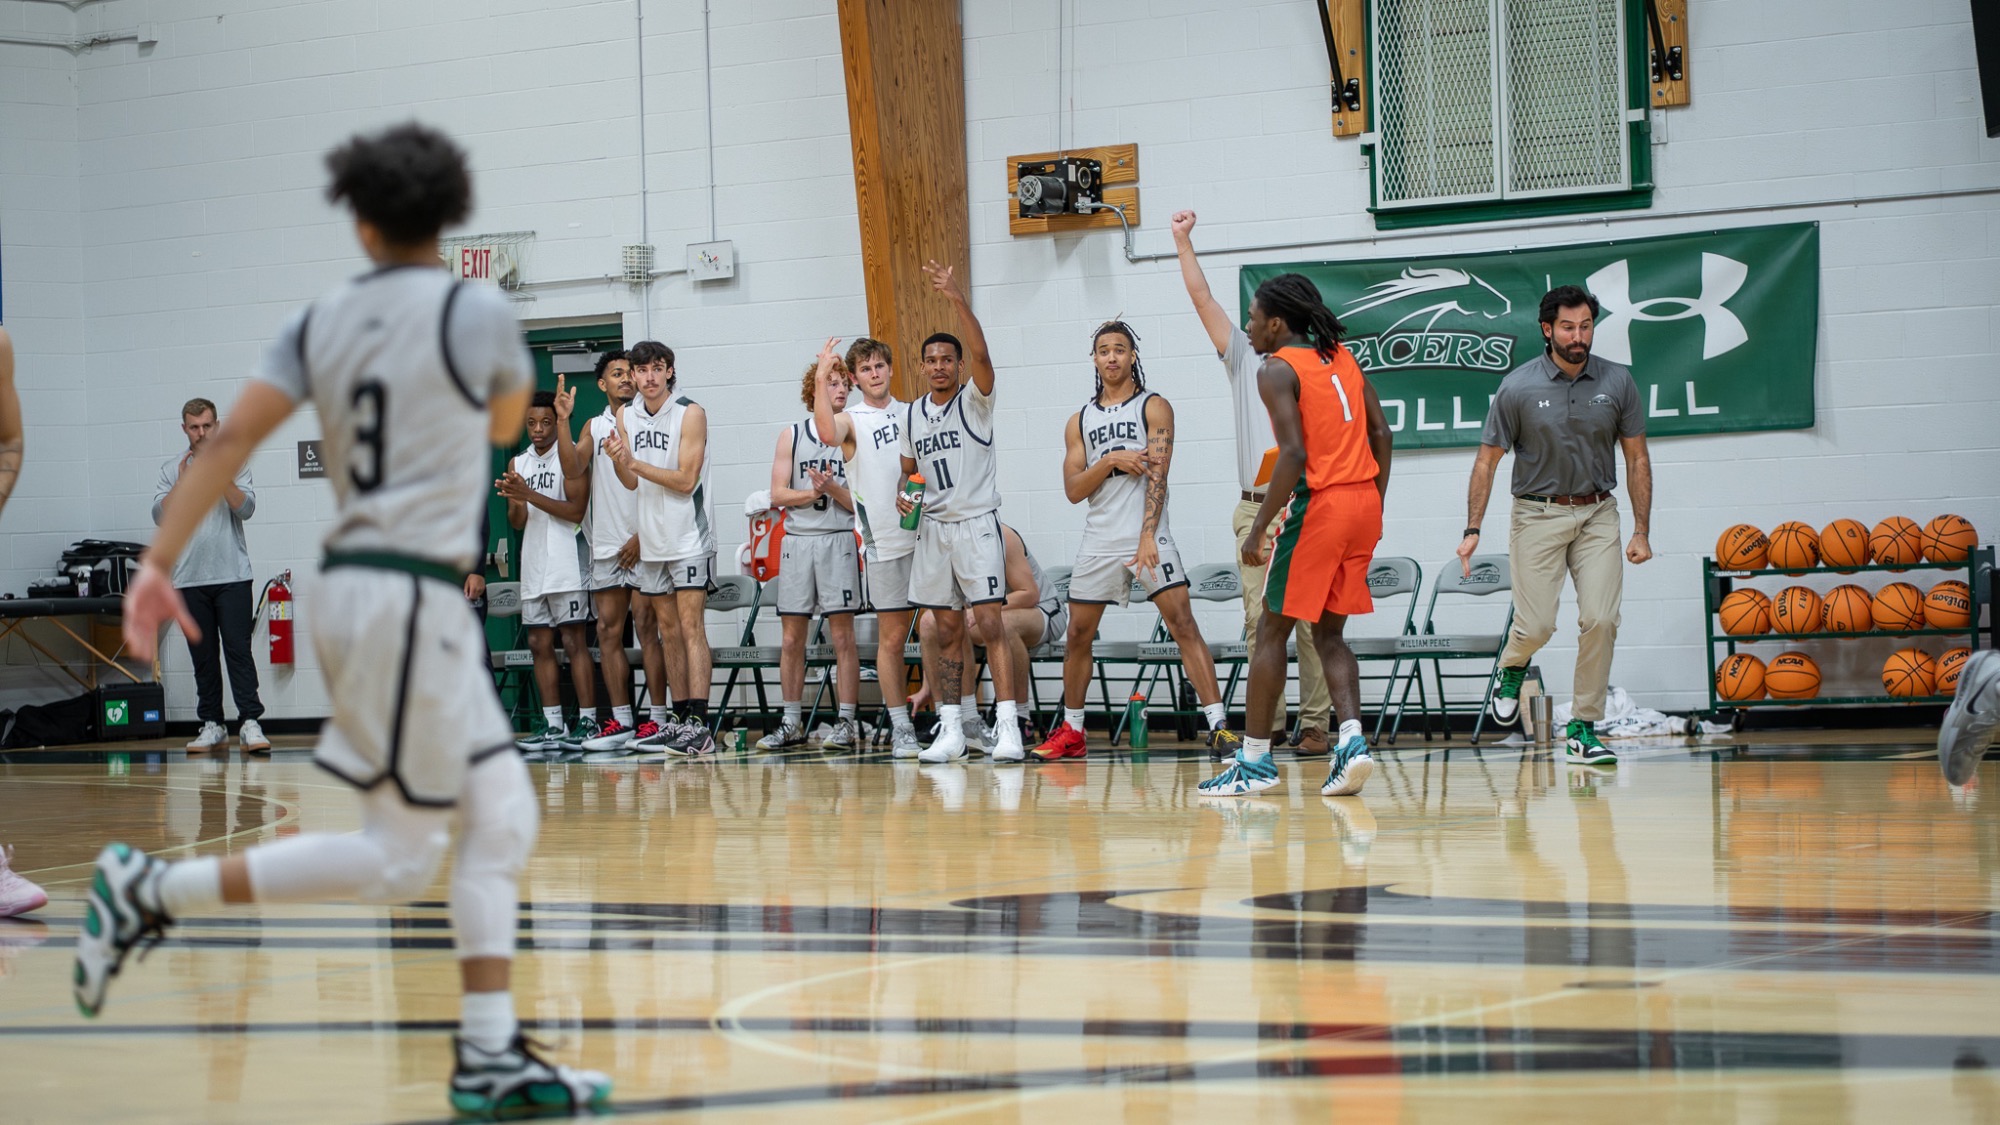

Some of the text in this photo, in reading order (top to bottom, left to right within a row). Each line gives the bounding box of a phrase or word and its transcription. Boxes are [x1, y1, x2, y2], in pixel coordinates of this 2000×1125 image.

[462, 249, 491, 279] EXIT
[1331, 373, 1354, 422] 1
[350, 379, 387, 494] 3
[634, 430, 670, 452] PEACE
[873, 423, 900, 450] PEA
[915, 430, 961, 460] PEACE
[1089, 421, 1137, 450] PEACE
[932, 457, 954, 491] 11
[752, 513, 767, 537] G
[687, 565, 697, 584] P
[1161, 561, 1175, 582] P
[987, 575, 998, 596] P
[842, 589, 852, 607] P
[1932, 594, 1969, 611] Wilson
[569, 600, 579, 618] P
[1400, 639, 1451, 648] WILLIAM PEACE
[717, 651, 760, 659] WILLIAM PEACE
[1776, 657, 1805, 667] NCAA
